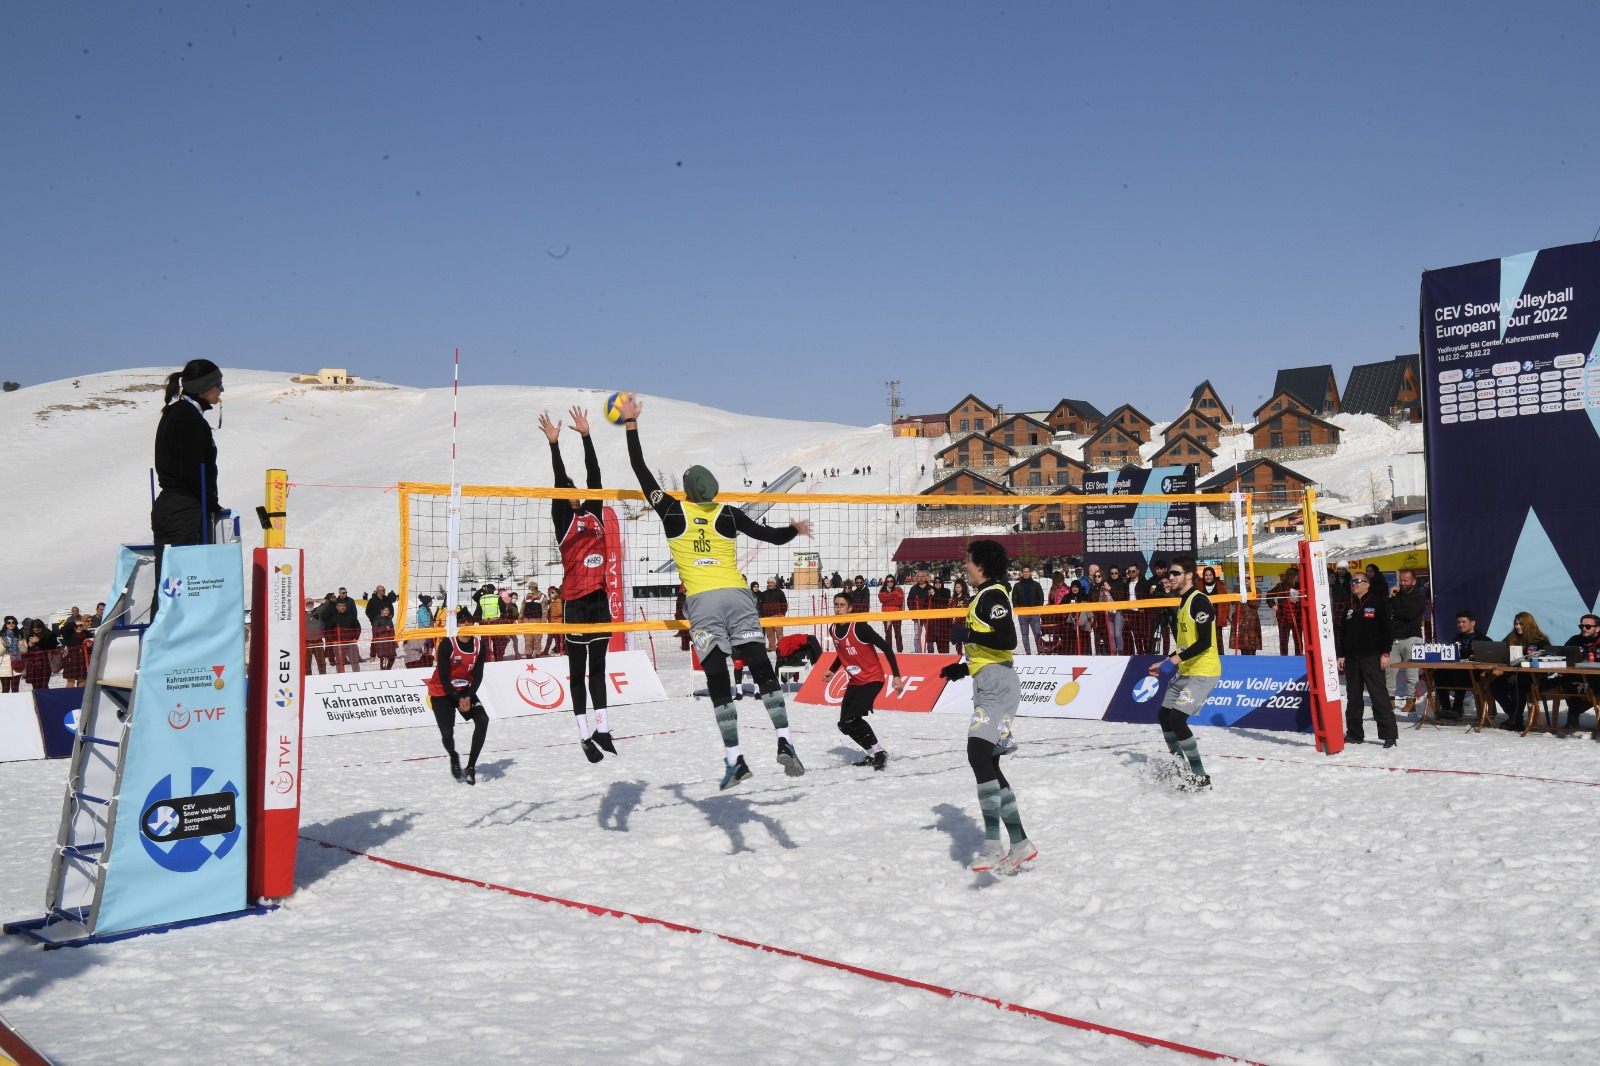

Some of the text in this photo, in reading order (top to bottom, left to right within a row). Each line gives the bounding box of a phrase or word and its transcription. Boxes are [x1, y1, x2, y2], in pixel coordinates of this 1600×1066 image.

[1435, 286, 1574, 322] CEV Snow Volleyball
[1436, 306, 1568, 338] European Tour 2022
[1470, 341, 1480, 350] Ski
[1505, 330, 1559, 344] Kahramanmaraş
[1465, 348, 1491, 359] 20.02.22
[1505, 365, 1518, 373] TVF
[698, 528, 705, 540] 3
[693, 539, 711, 553] RUS
[1412, 648, 1423, 659] 12
[1442, 648, 1452, 659] 13
[279, 649, 291, 684] CEV
[166, 674, 212, 684] Kahramanmaraş
[1214, 679, 1243, 690] now
[885, 674, 925, 699] VF
[322, 691, 421, 710] Kahramanmaraş
[1236, 694, 1267, 708] Tour
[1266, 695, 1303, 709] 2022
[194, 707, 226, 723] TVF
[327, 703, 426, 722] Büyükşehir Belediyesi
[278, 735, 291, 767] TVF
[182, 803, 196, 811] CEV
[200, 804, 231, 815] Volleyball
[184, 815, 212, 824] European
[183, 824, 200, 832] 2022
